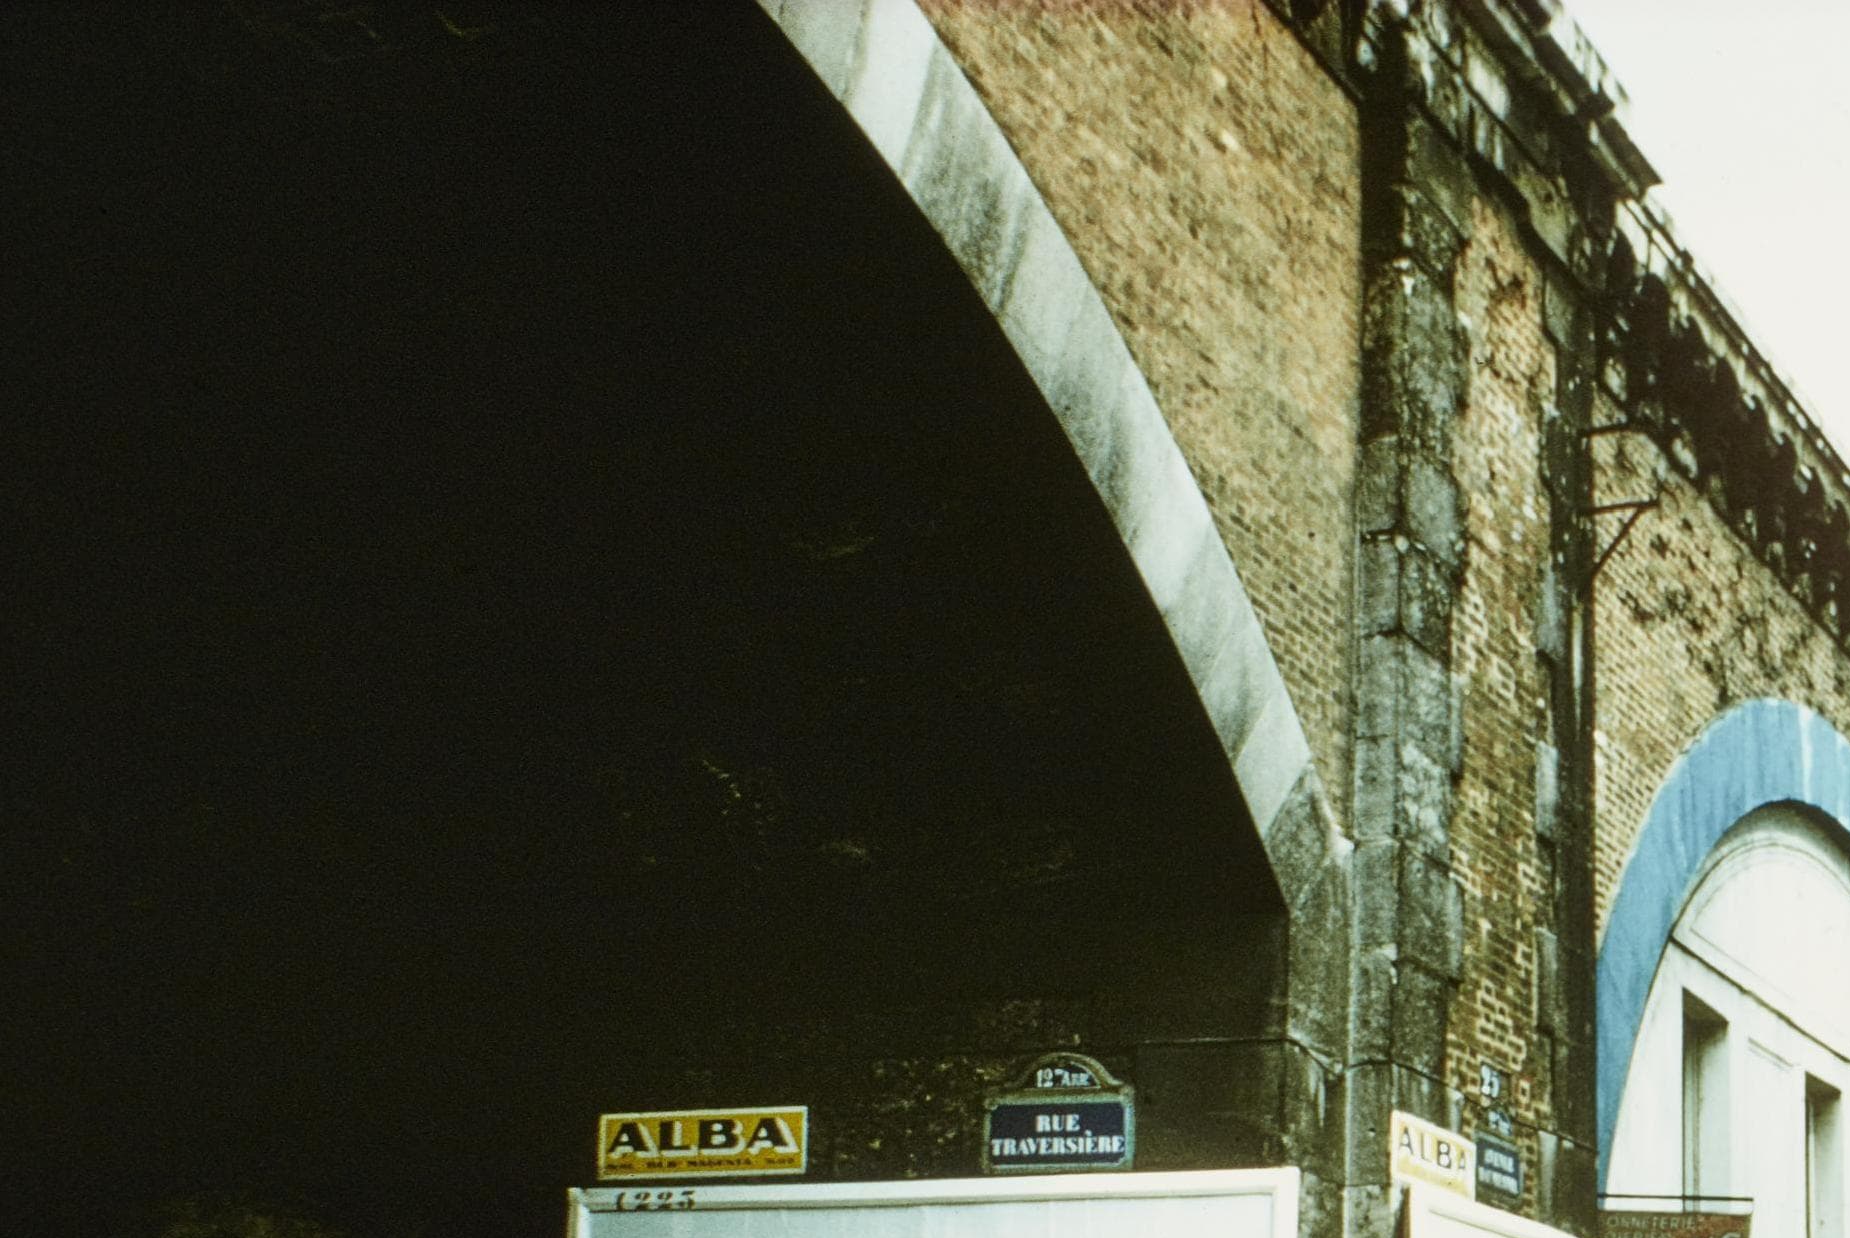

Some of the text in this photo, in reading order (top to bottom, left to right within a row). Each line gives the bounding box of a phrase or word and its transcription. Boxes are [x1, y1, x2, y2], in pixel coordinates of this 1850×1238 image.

[608, 1117, 800, 1159] ALBA
[1036, 1114, 1081, 1133] RUE
[991, 1130, 1126, 1156] TRAVERSIÈRE
[1399, 1126, 1467, 1170] ALBA
